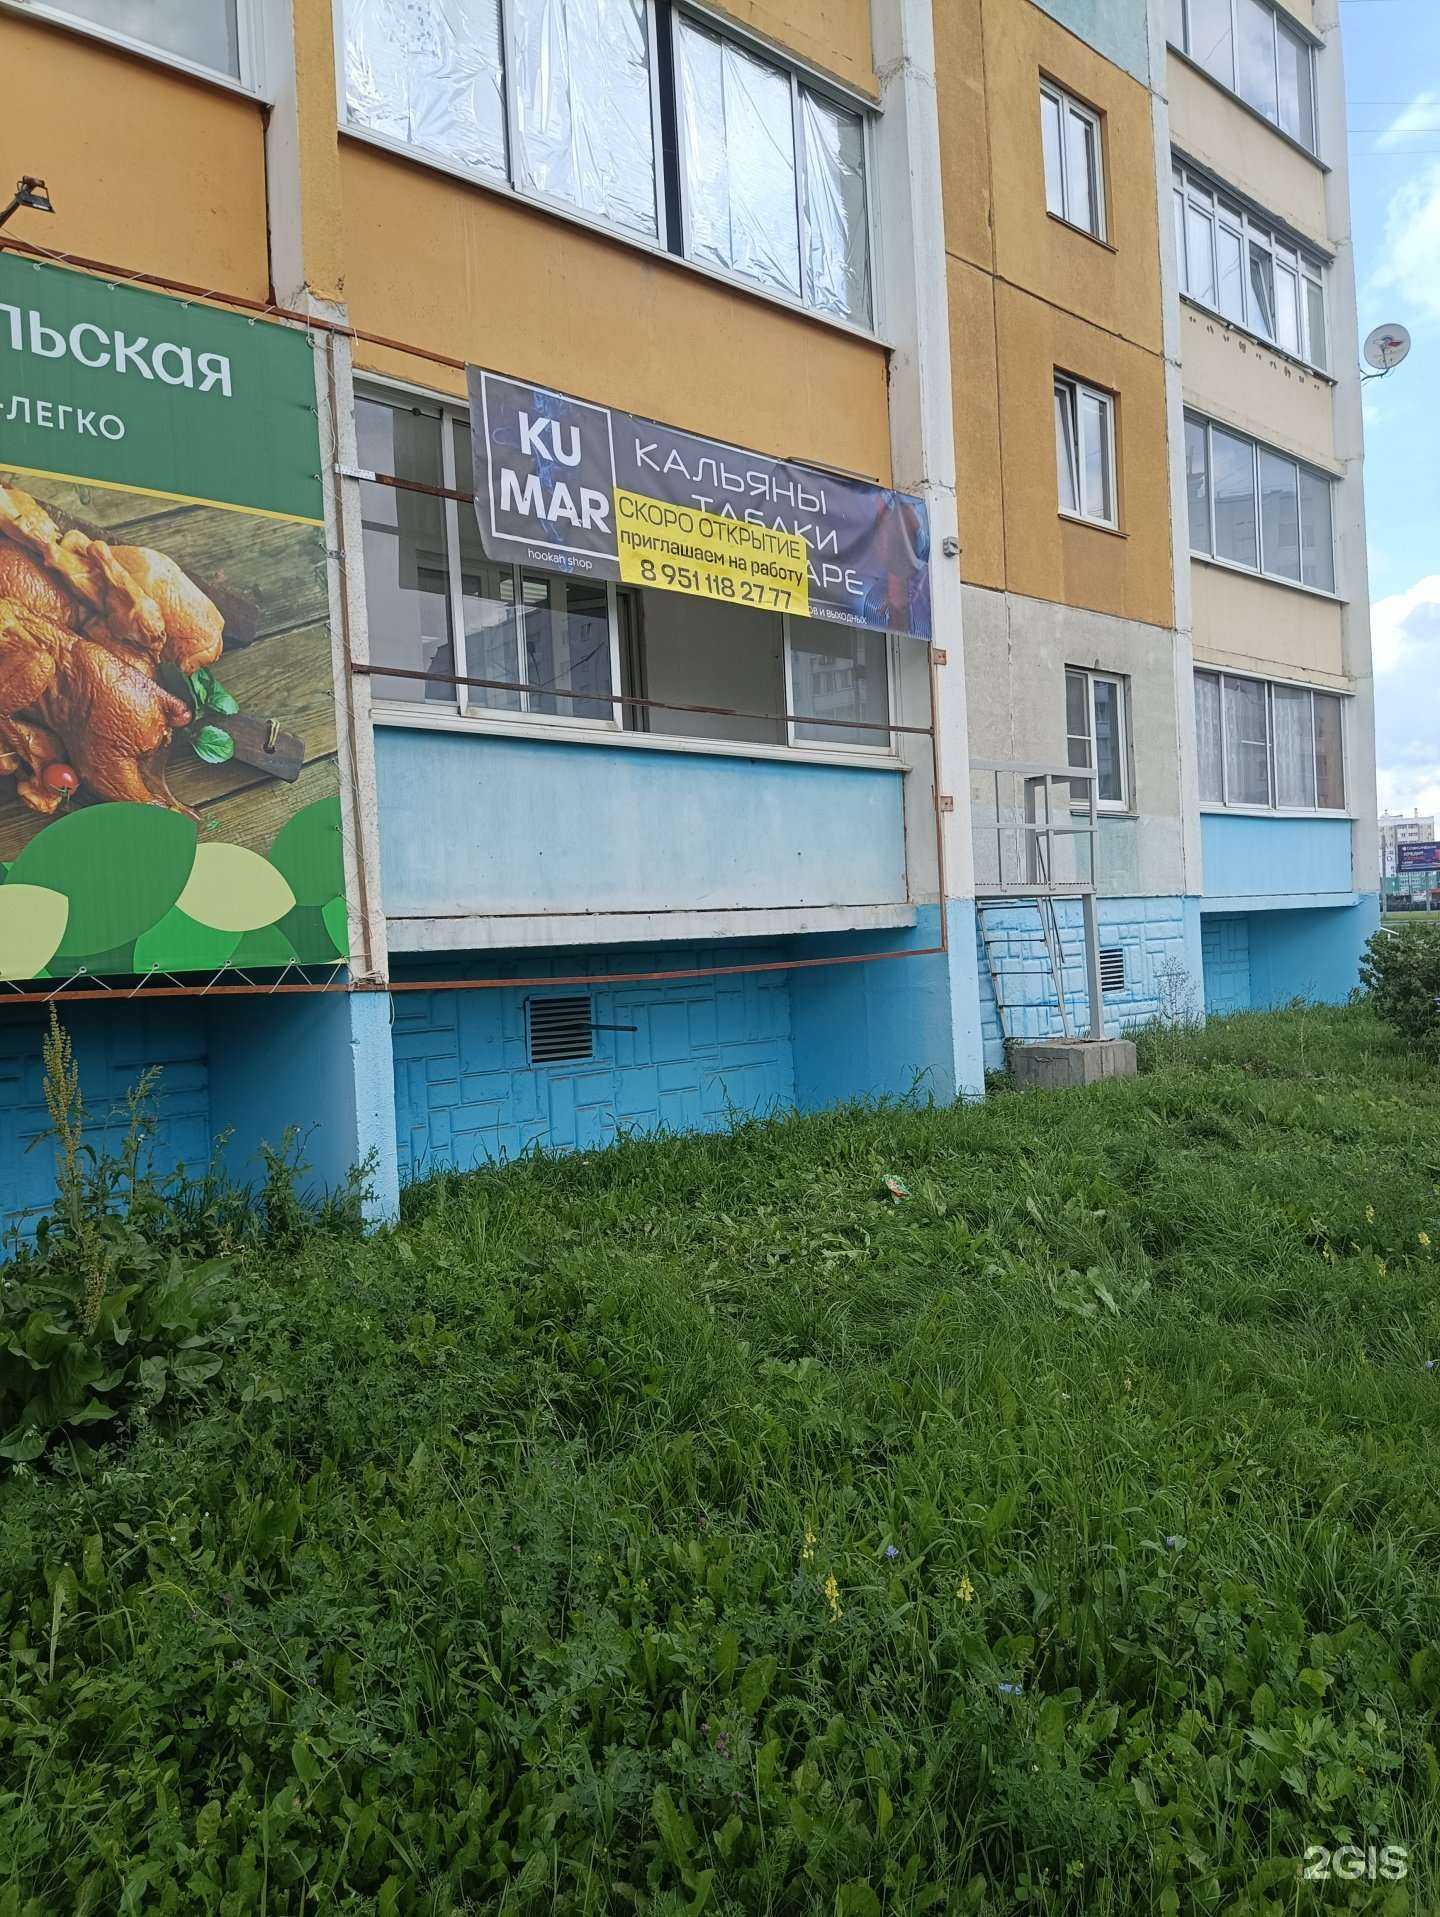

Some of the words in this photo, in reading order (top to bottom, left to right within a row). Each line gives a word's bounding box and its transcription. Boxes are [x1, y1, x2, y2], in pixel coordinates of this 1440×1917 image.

[518, 411, 582, 467] KU
[500, 467, 612, 534] MAR
[634, 438, 827, 515] КАЛЬЯНЫ
[618, 496, 694, 533] СКОРО
[699, 518, 801, 560] ОТКРЫТИЕ
[528, 548, 566, 564] hookah
[567, 556, 592, 570] shop
[620, 530, 725, 566] приглашаем
[729, 555, 747, 571] на
[750, 560, 803, 587] работу
[640, 559, 657, 581] 8
[661, 564, 700, 591] 951
[705, 573, 736, 598] 118
[740, 581, 765, 603] 27
[769, 587, 792, 609] 77
